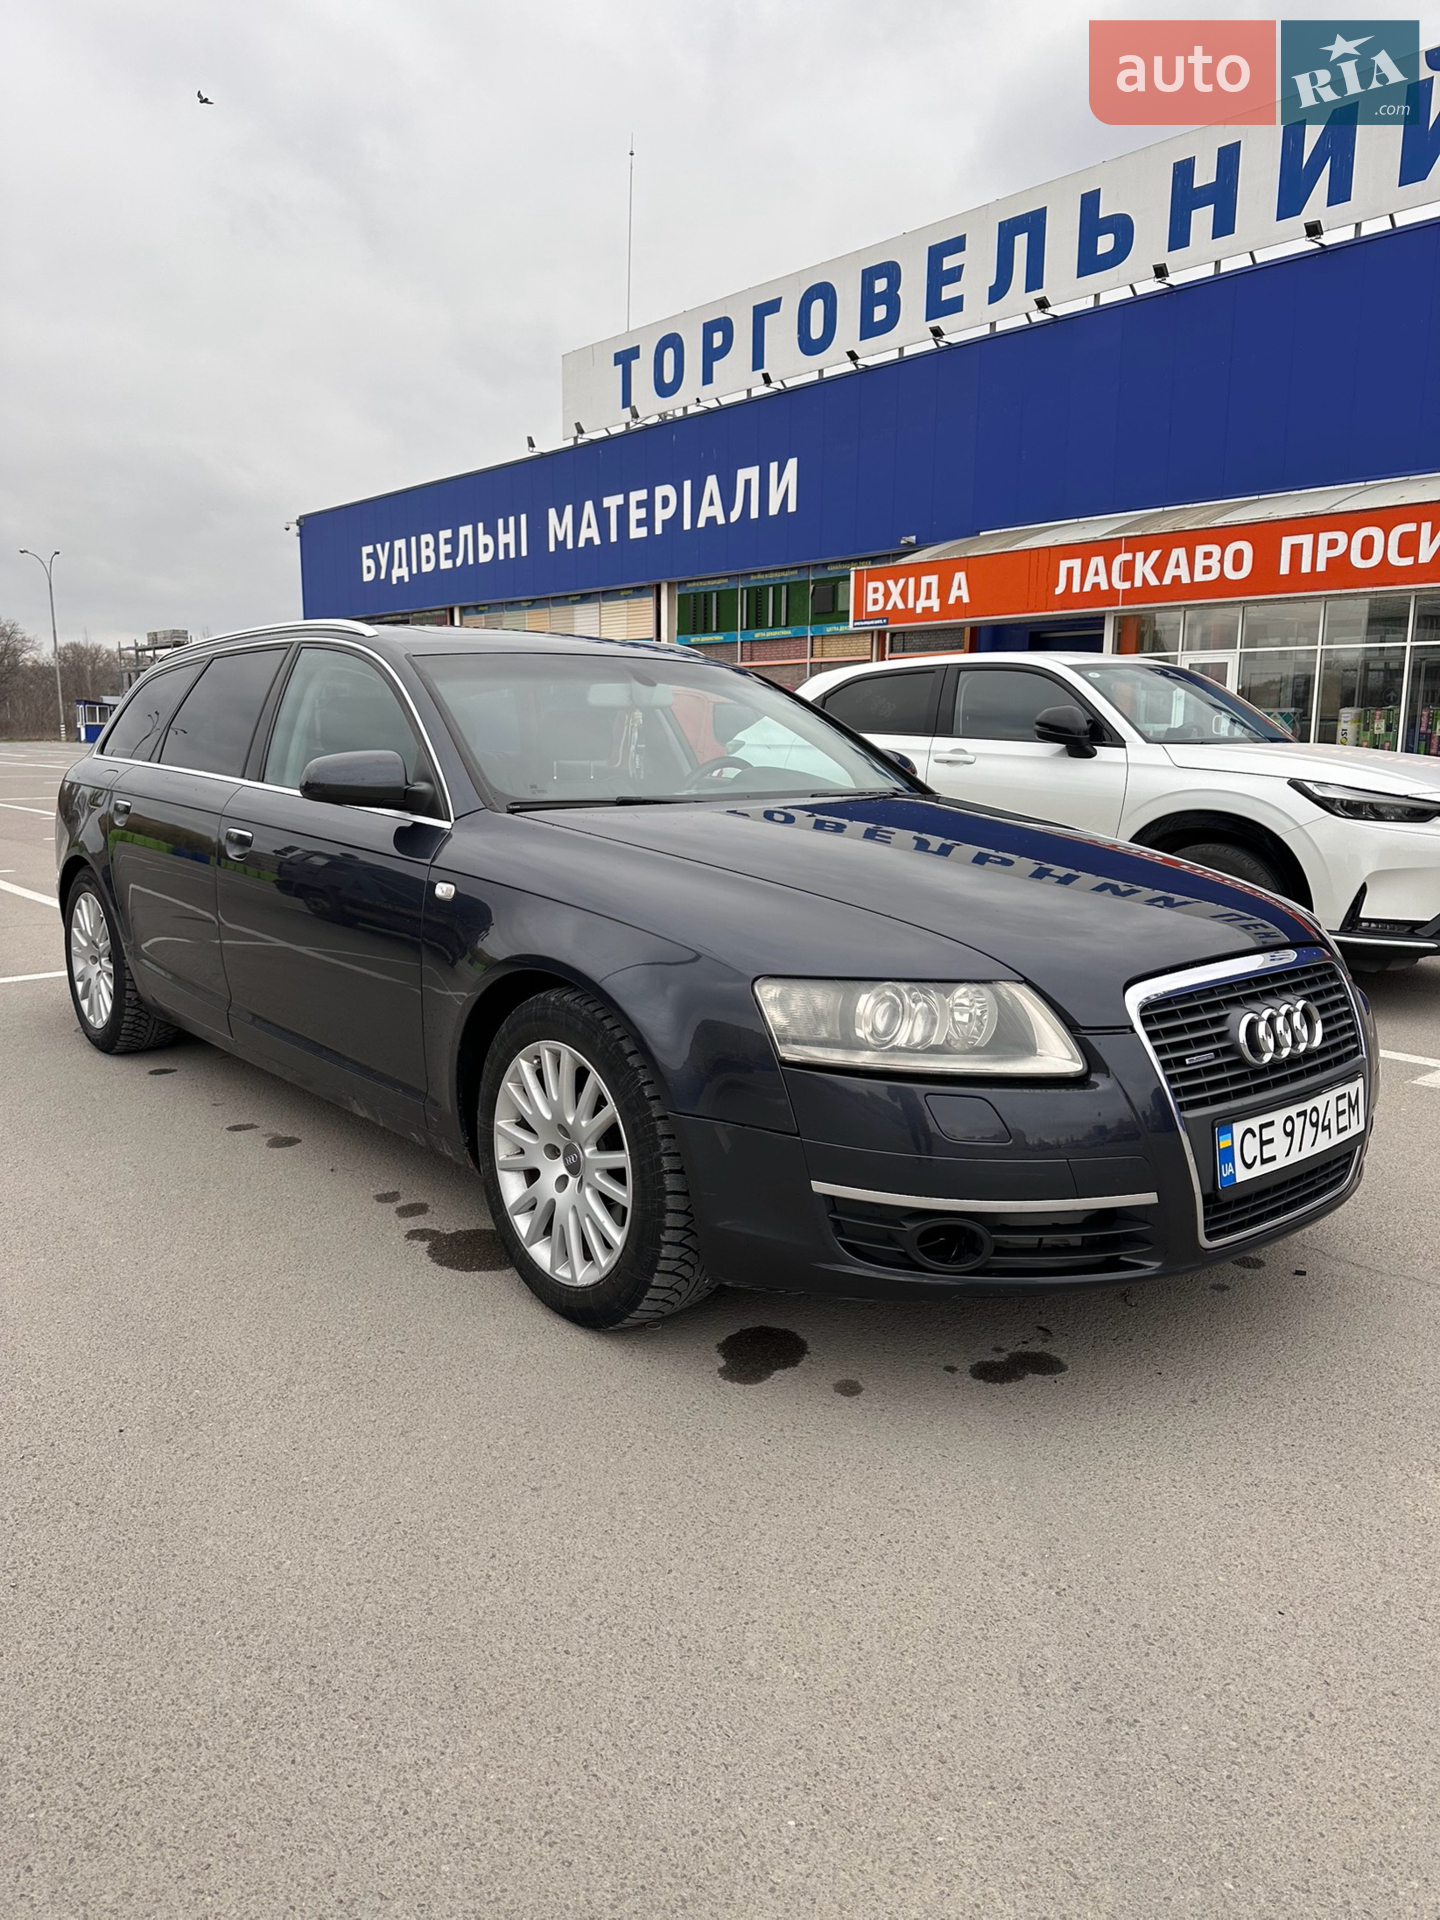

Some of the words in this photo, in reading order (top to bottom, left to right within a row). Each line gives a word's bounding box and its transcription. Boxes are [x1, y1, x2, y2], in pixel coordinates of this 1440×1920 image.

[361, 513, 528, 585] БУДІВЕЛЬНІ
[548, 457, 798, 553] МАТЕРІАЛИ
[866, 574, 941, 614] ВХІД
[1054, 540, 1254, 595] ЛАСКАВО
[1239, 1119, 1277, 1170] CE
[1282, 1099, 1332, 1158] 9794
[1335, 1086, 1360, 1136] EM
[1221, 1163, 1235, 1178] UA
